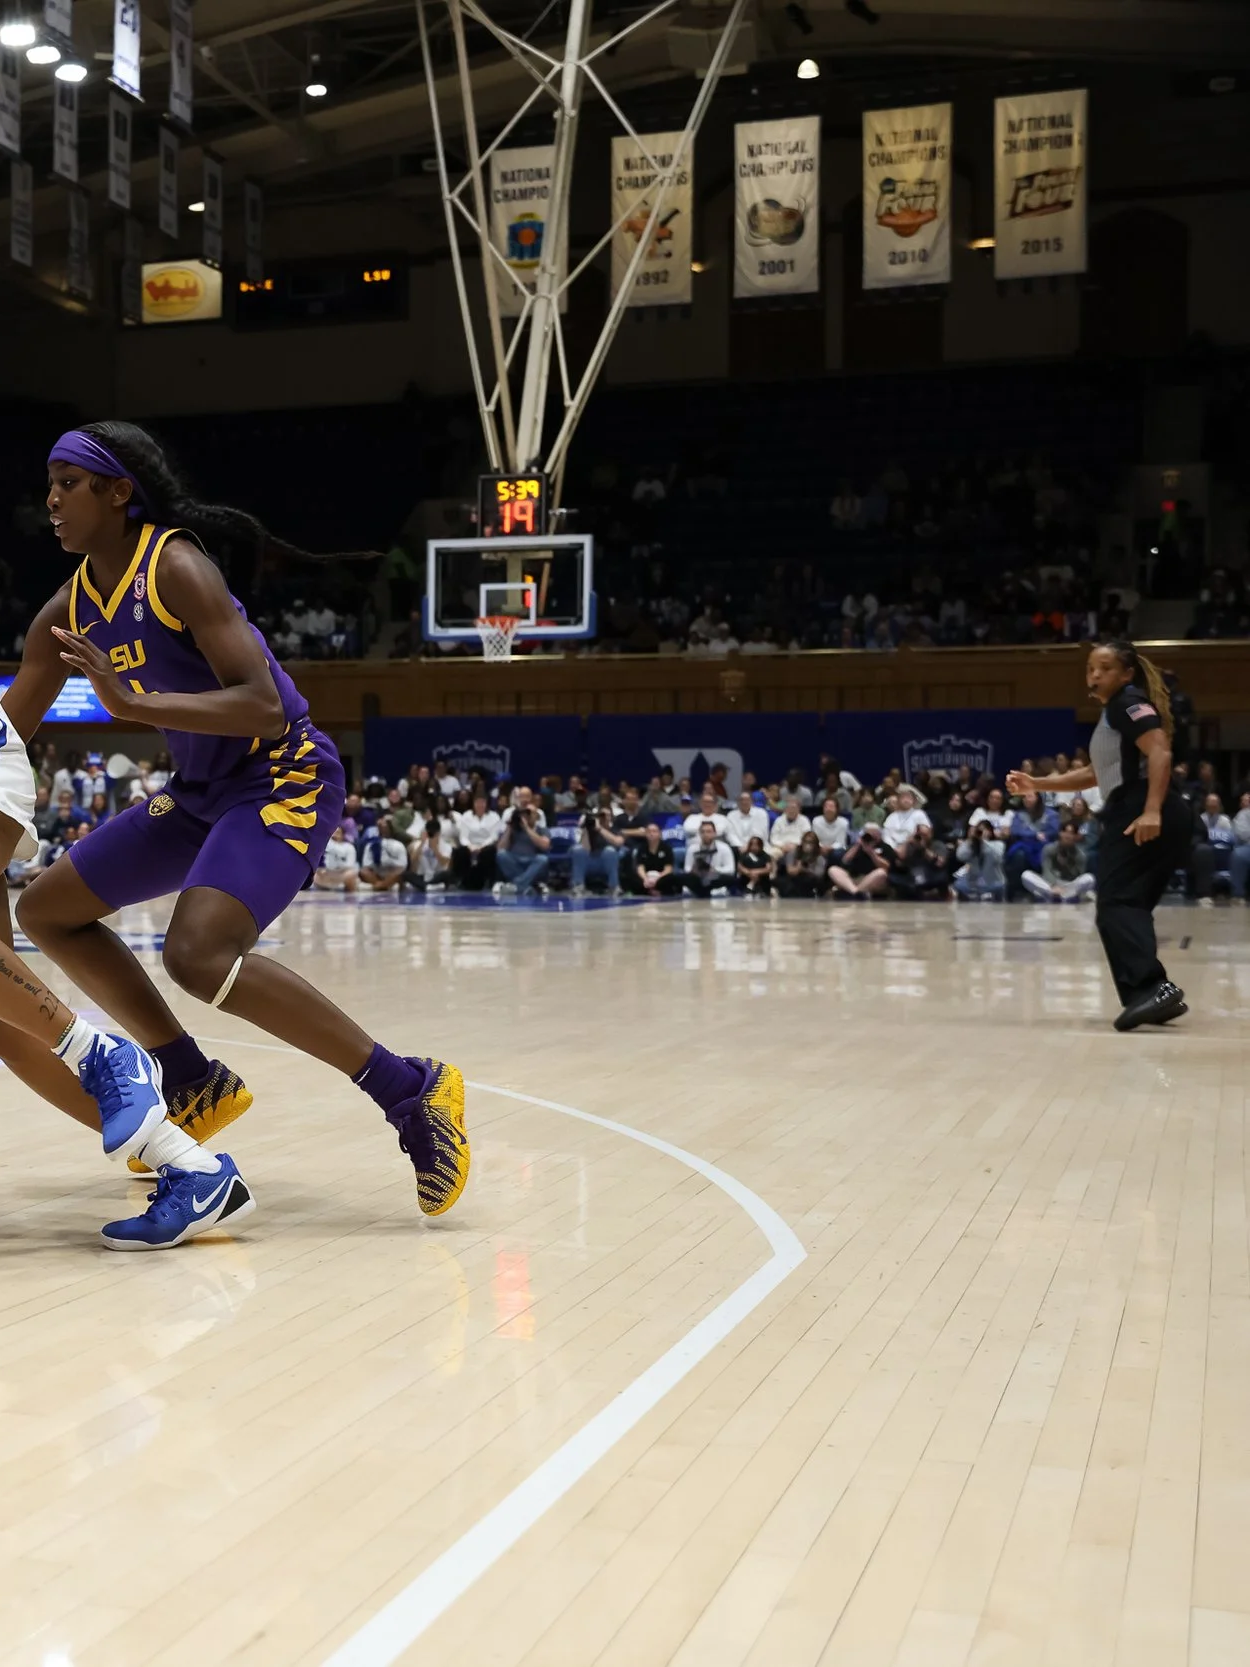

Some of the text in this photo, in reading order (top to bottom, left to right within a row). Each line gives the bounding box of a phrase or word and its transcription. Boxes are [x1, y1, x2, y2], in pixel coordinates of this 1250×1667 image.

[1008, 113, 1073, 134] NATIONAL
[876, 128, 938, 147] NATIONAL
[747, 140, 808, 159] NATIONAL
[623, 153, 684, 172] NATIONA
[500, 167, 550, 185] NATIONA
[494, 186, 549, 204] CHAMPIO
[1021, 239, 1063, 255] 2015
[888, 249, 928, 265] 2010
[758, 261, 794, 276] 2001
[497, 480, 539, 501] 5:39
[503, 500, 534, 533] 19
[109, 639, 146, 672] SU
[910, 752, 985, 773] SISTERHOOD
